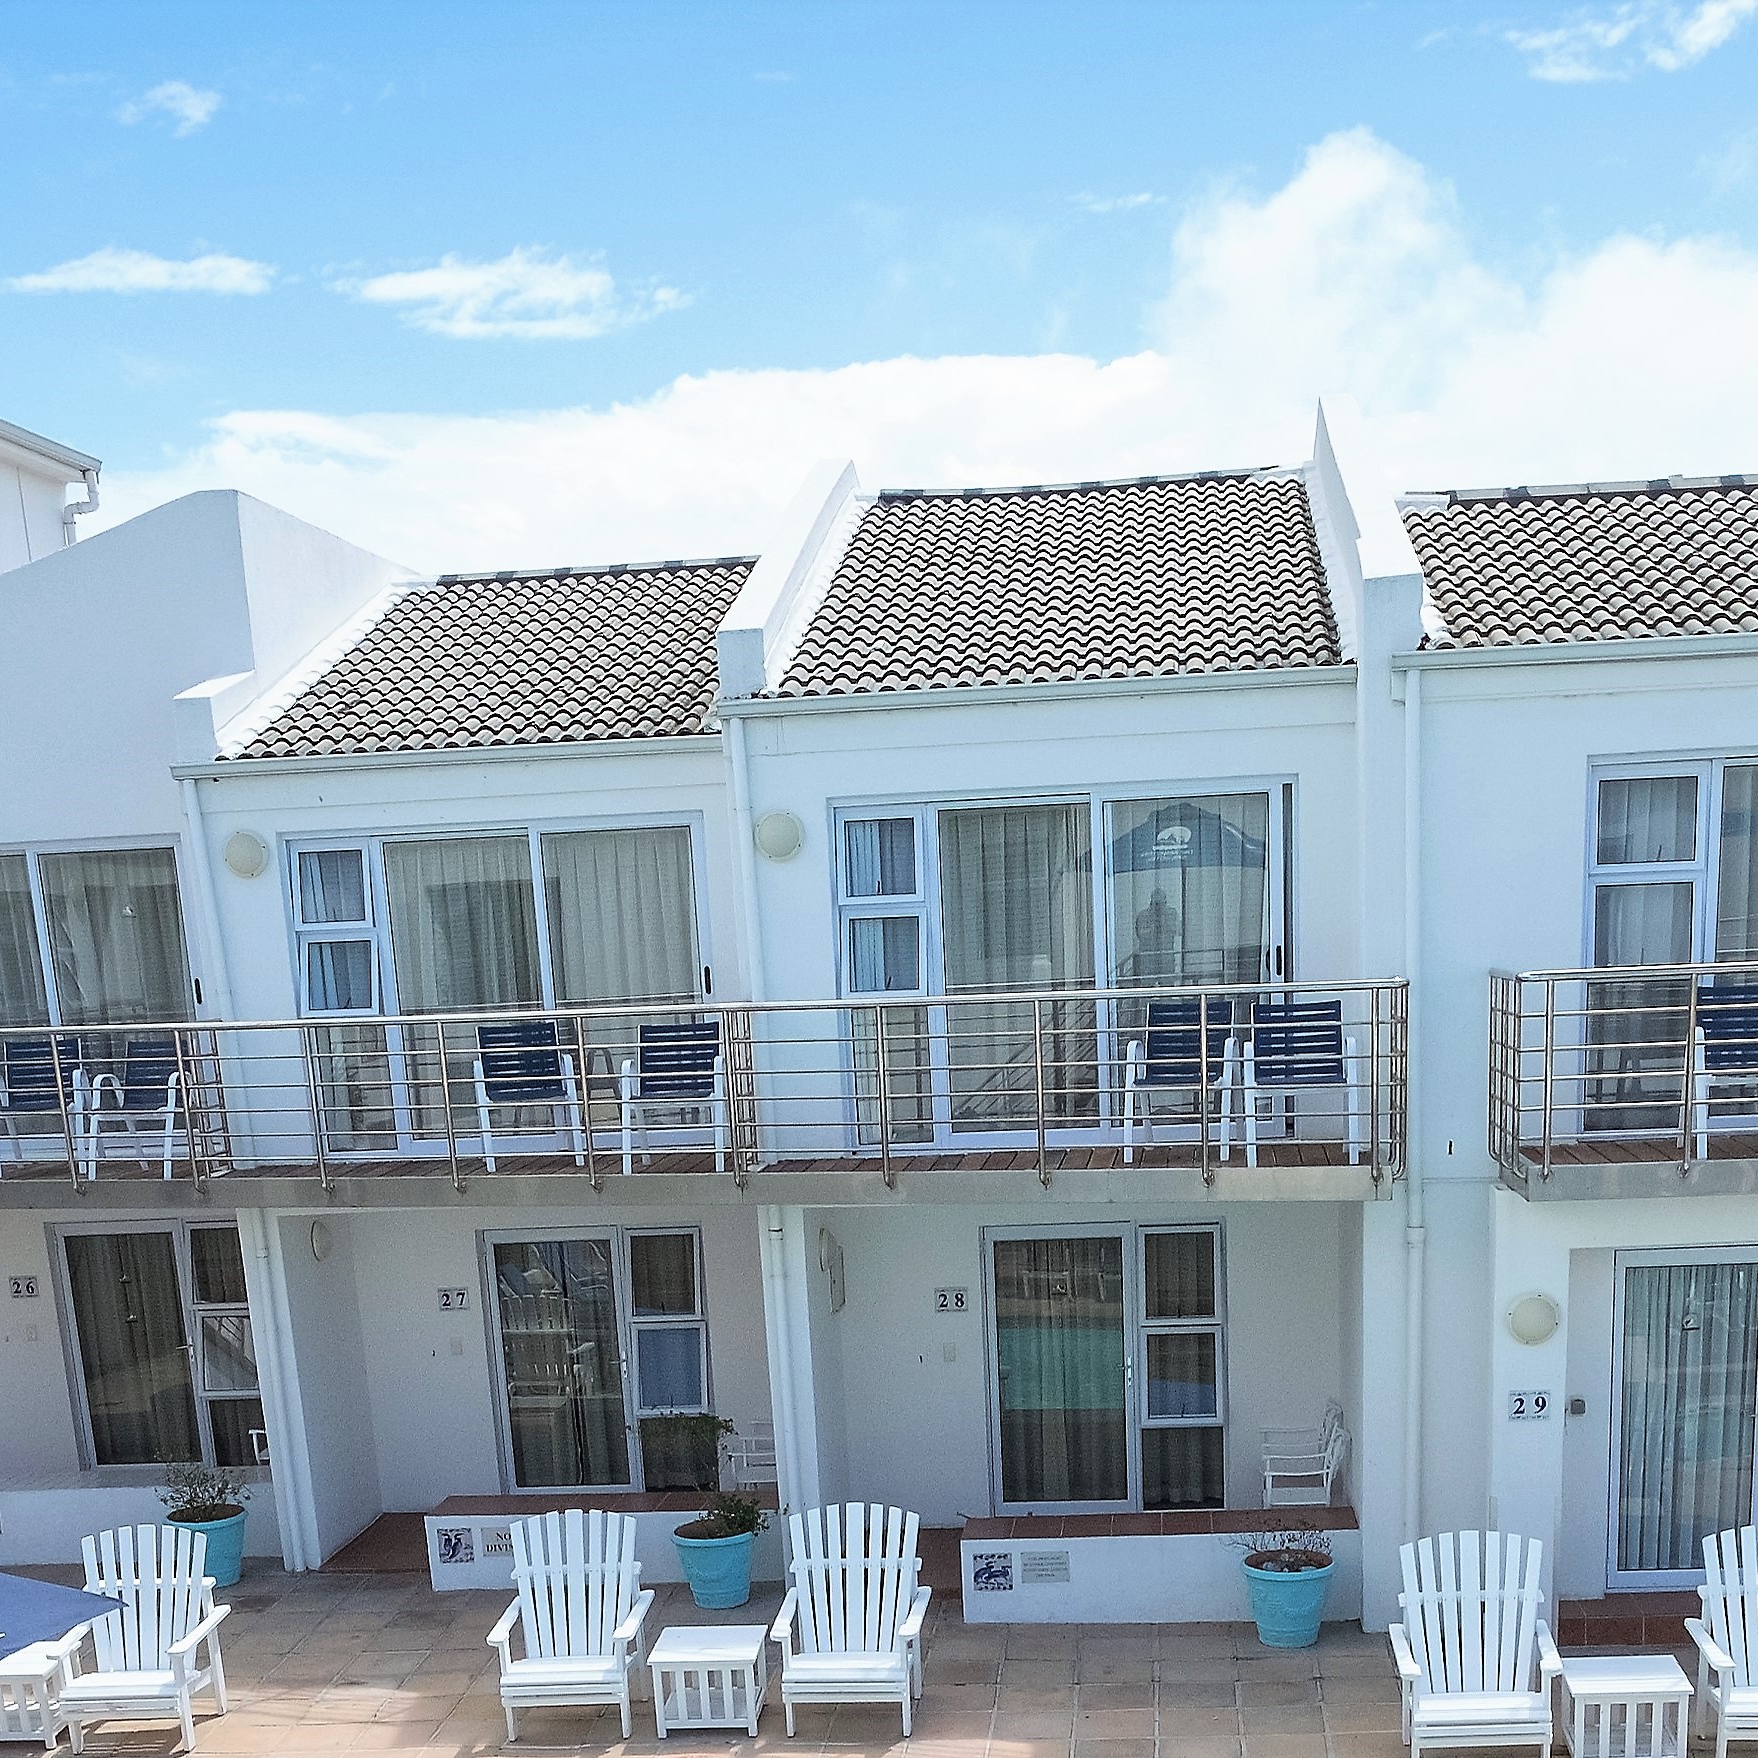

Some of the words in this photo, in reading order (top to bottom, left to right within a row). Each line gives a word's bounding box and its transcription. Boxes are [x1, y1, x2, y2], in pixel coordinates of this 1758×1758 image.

[12, 1280, 35, 1294] 26
[441, 1291, 466, 1307] 27
[938, 1292, 965, 1308] 28
[1513, 1396, 1547, 1415] 29
